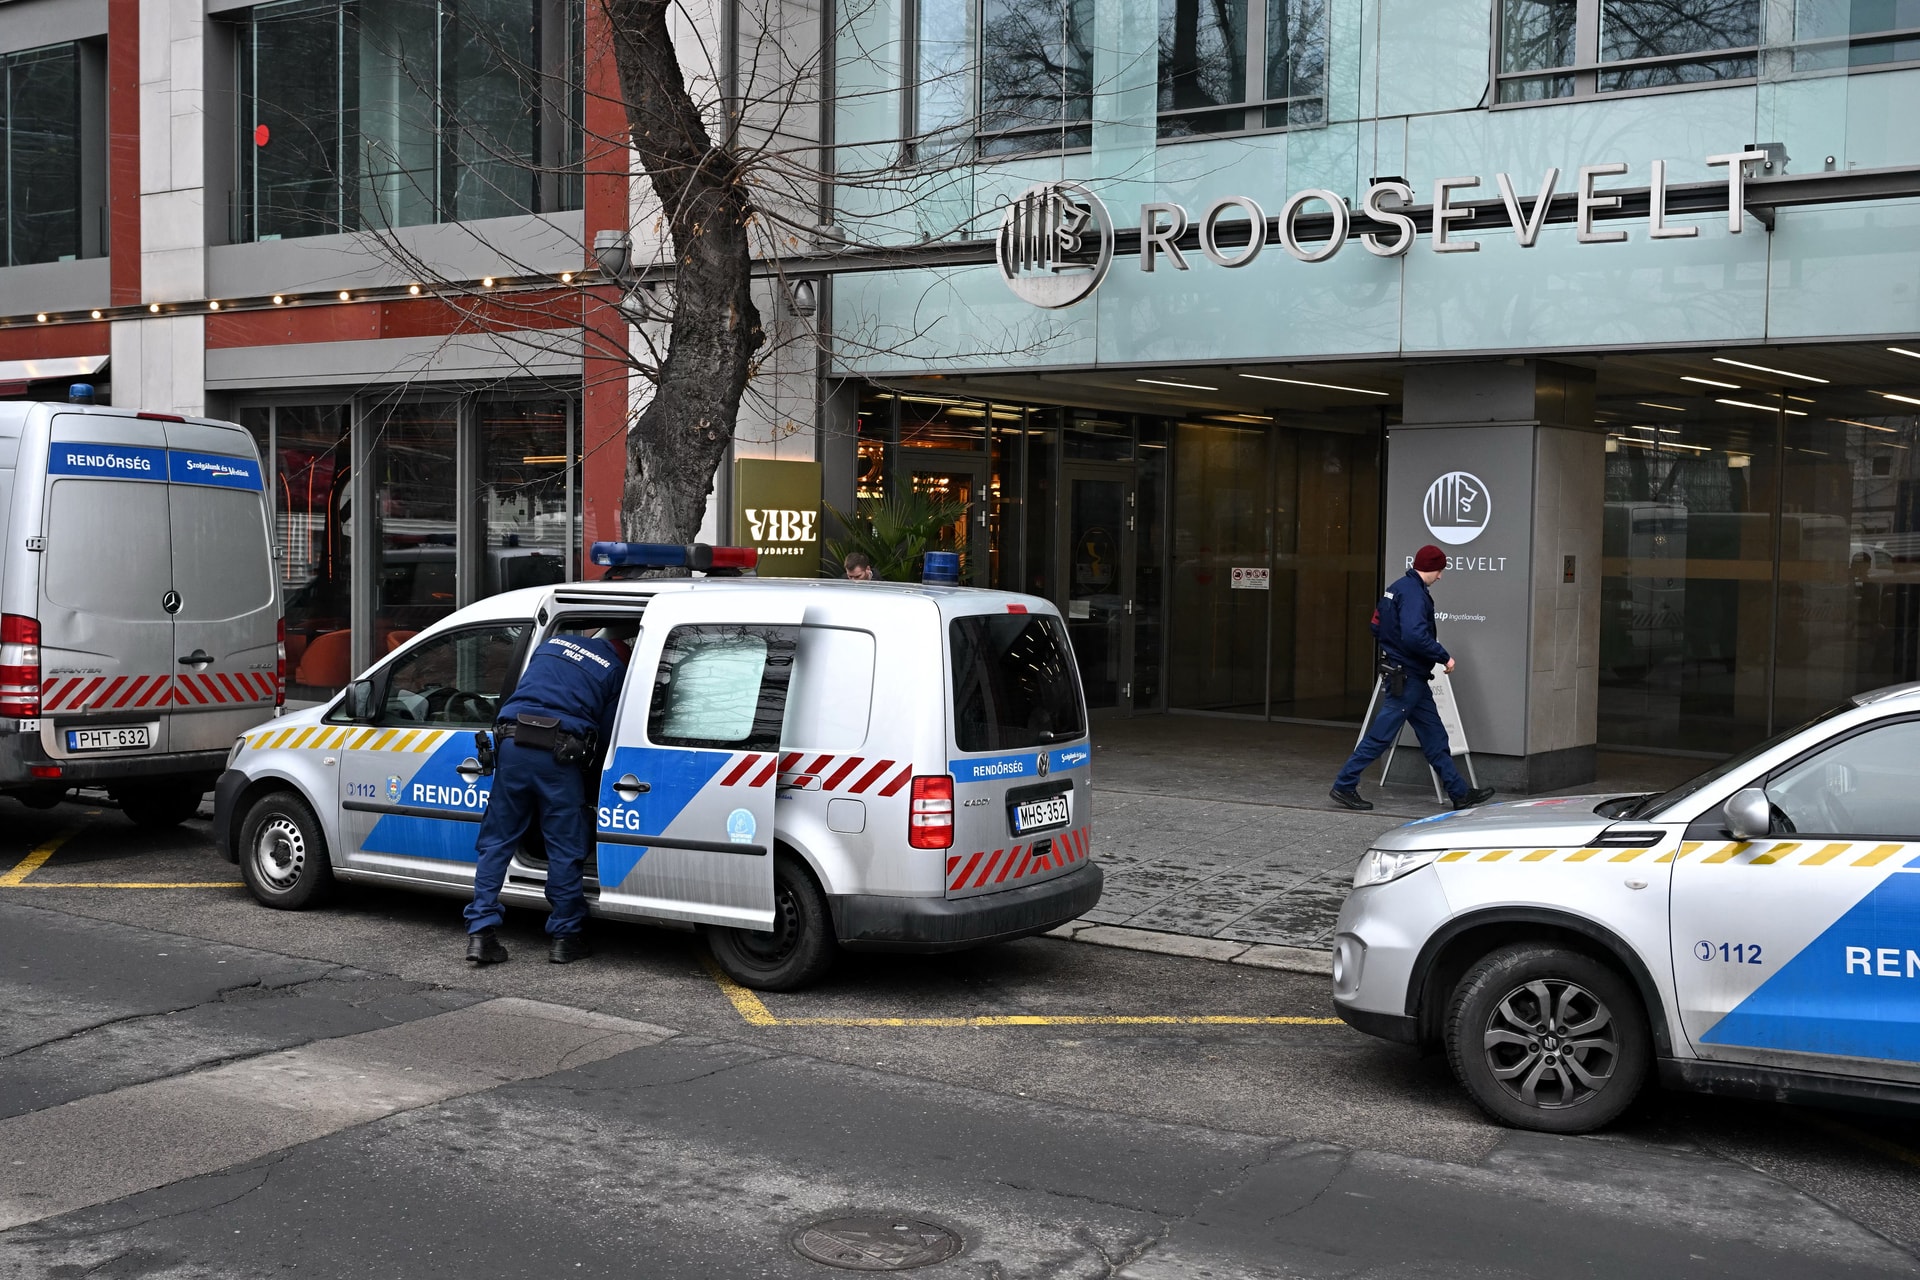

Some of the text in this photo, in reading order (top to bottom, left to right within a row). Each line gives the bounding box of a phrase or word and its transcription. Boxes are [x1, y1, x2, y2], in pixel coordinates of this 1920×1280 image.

[1140, 150, 1768, 272] ROOSEVELT
[67, 454, 151, 471] RENDŐRSÉG
[745, 509, 817, 541] VIBE
[757, 547, 804, 555] BUDAPEST
[1405, 556, 1507, 571] RSEVELT
[1434, 611, 1449, 622] otp
[562, 648, 585, 661] POLICE
[79, 730, 145, 747] PHT-632
[973, 760, 1023, 777] RENDŐRSÉG
[357, 783, 376, 798] 112
[1020, 801, 1066, 827] MHS-352
[1719, 942, 1762, 965] 112
